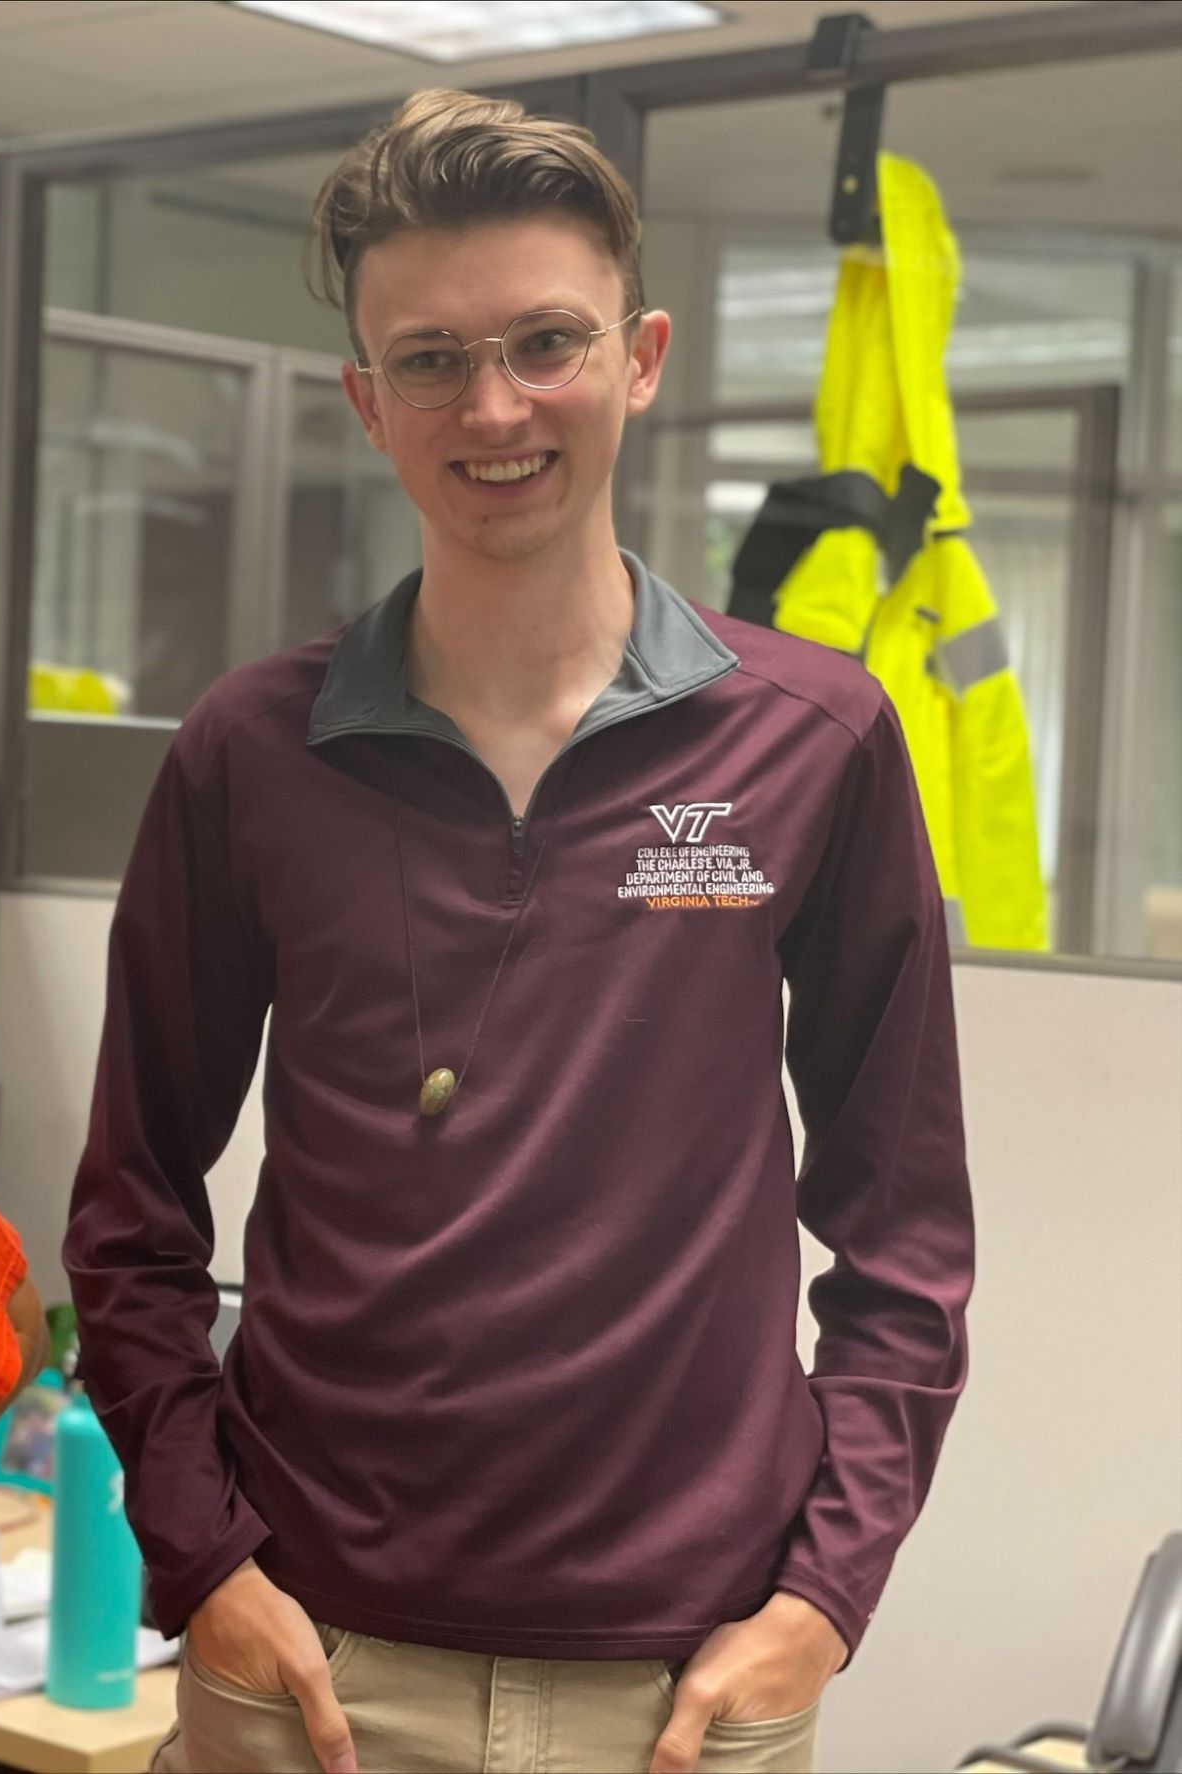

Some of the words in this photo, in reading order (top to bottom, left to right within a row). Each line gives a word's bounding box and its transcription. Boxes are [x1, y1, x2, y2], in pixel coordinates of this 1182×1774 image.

[649, 803, 732, 843] VT
[638, 847, 677, 858] COLLEGE
[679, 847, 690, 857] OF
[691, 845, 750, 857] ENGINEERING
[636, 859, 656, 871] THE
[658, 858, 704, 871] CHARLES
[737, 858, 752, 870] JR.
[626, 870, 695, 885] DEPARTMENT
[697, 870, 710, 882] OF
[711, 869, 738, 882] CIVIL
[741, 870, 764, 882] AND
[618, 883, 704, 898] ENVIRONMENTAL
[706, 882, 775, 896] ENGINEERING
[646, 896, 710, 908] VIRGINIA
